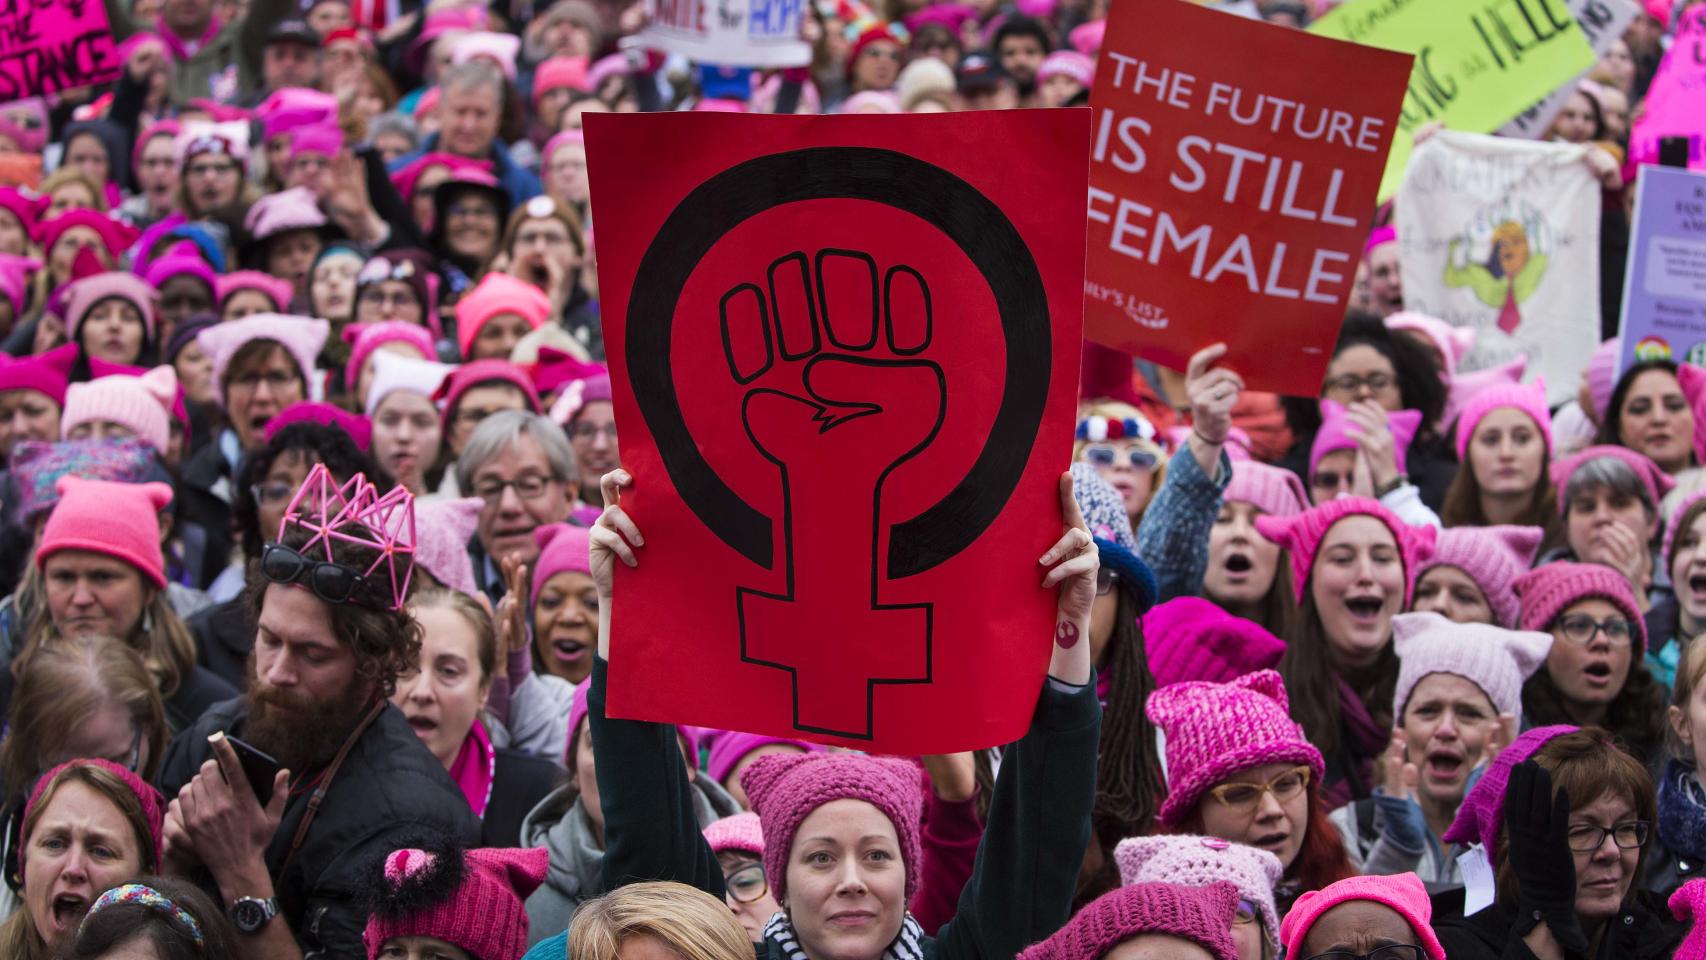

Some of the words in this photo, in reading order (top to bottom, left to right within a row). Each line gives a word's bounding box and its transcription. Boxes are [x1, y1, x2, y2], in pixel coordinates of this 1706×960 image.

[1108, 51, 1196, 109] THE
[1205, 82, 1384, 152] FUTURE
[1093, 108, 1152, 173] IS
[1169, 135, 1357, 227] STILL
[1087, 186, 1349, 304] FEMALE
